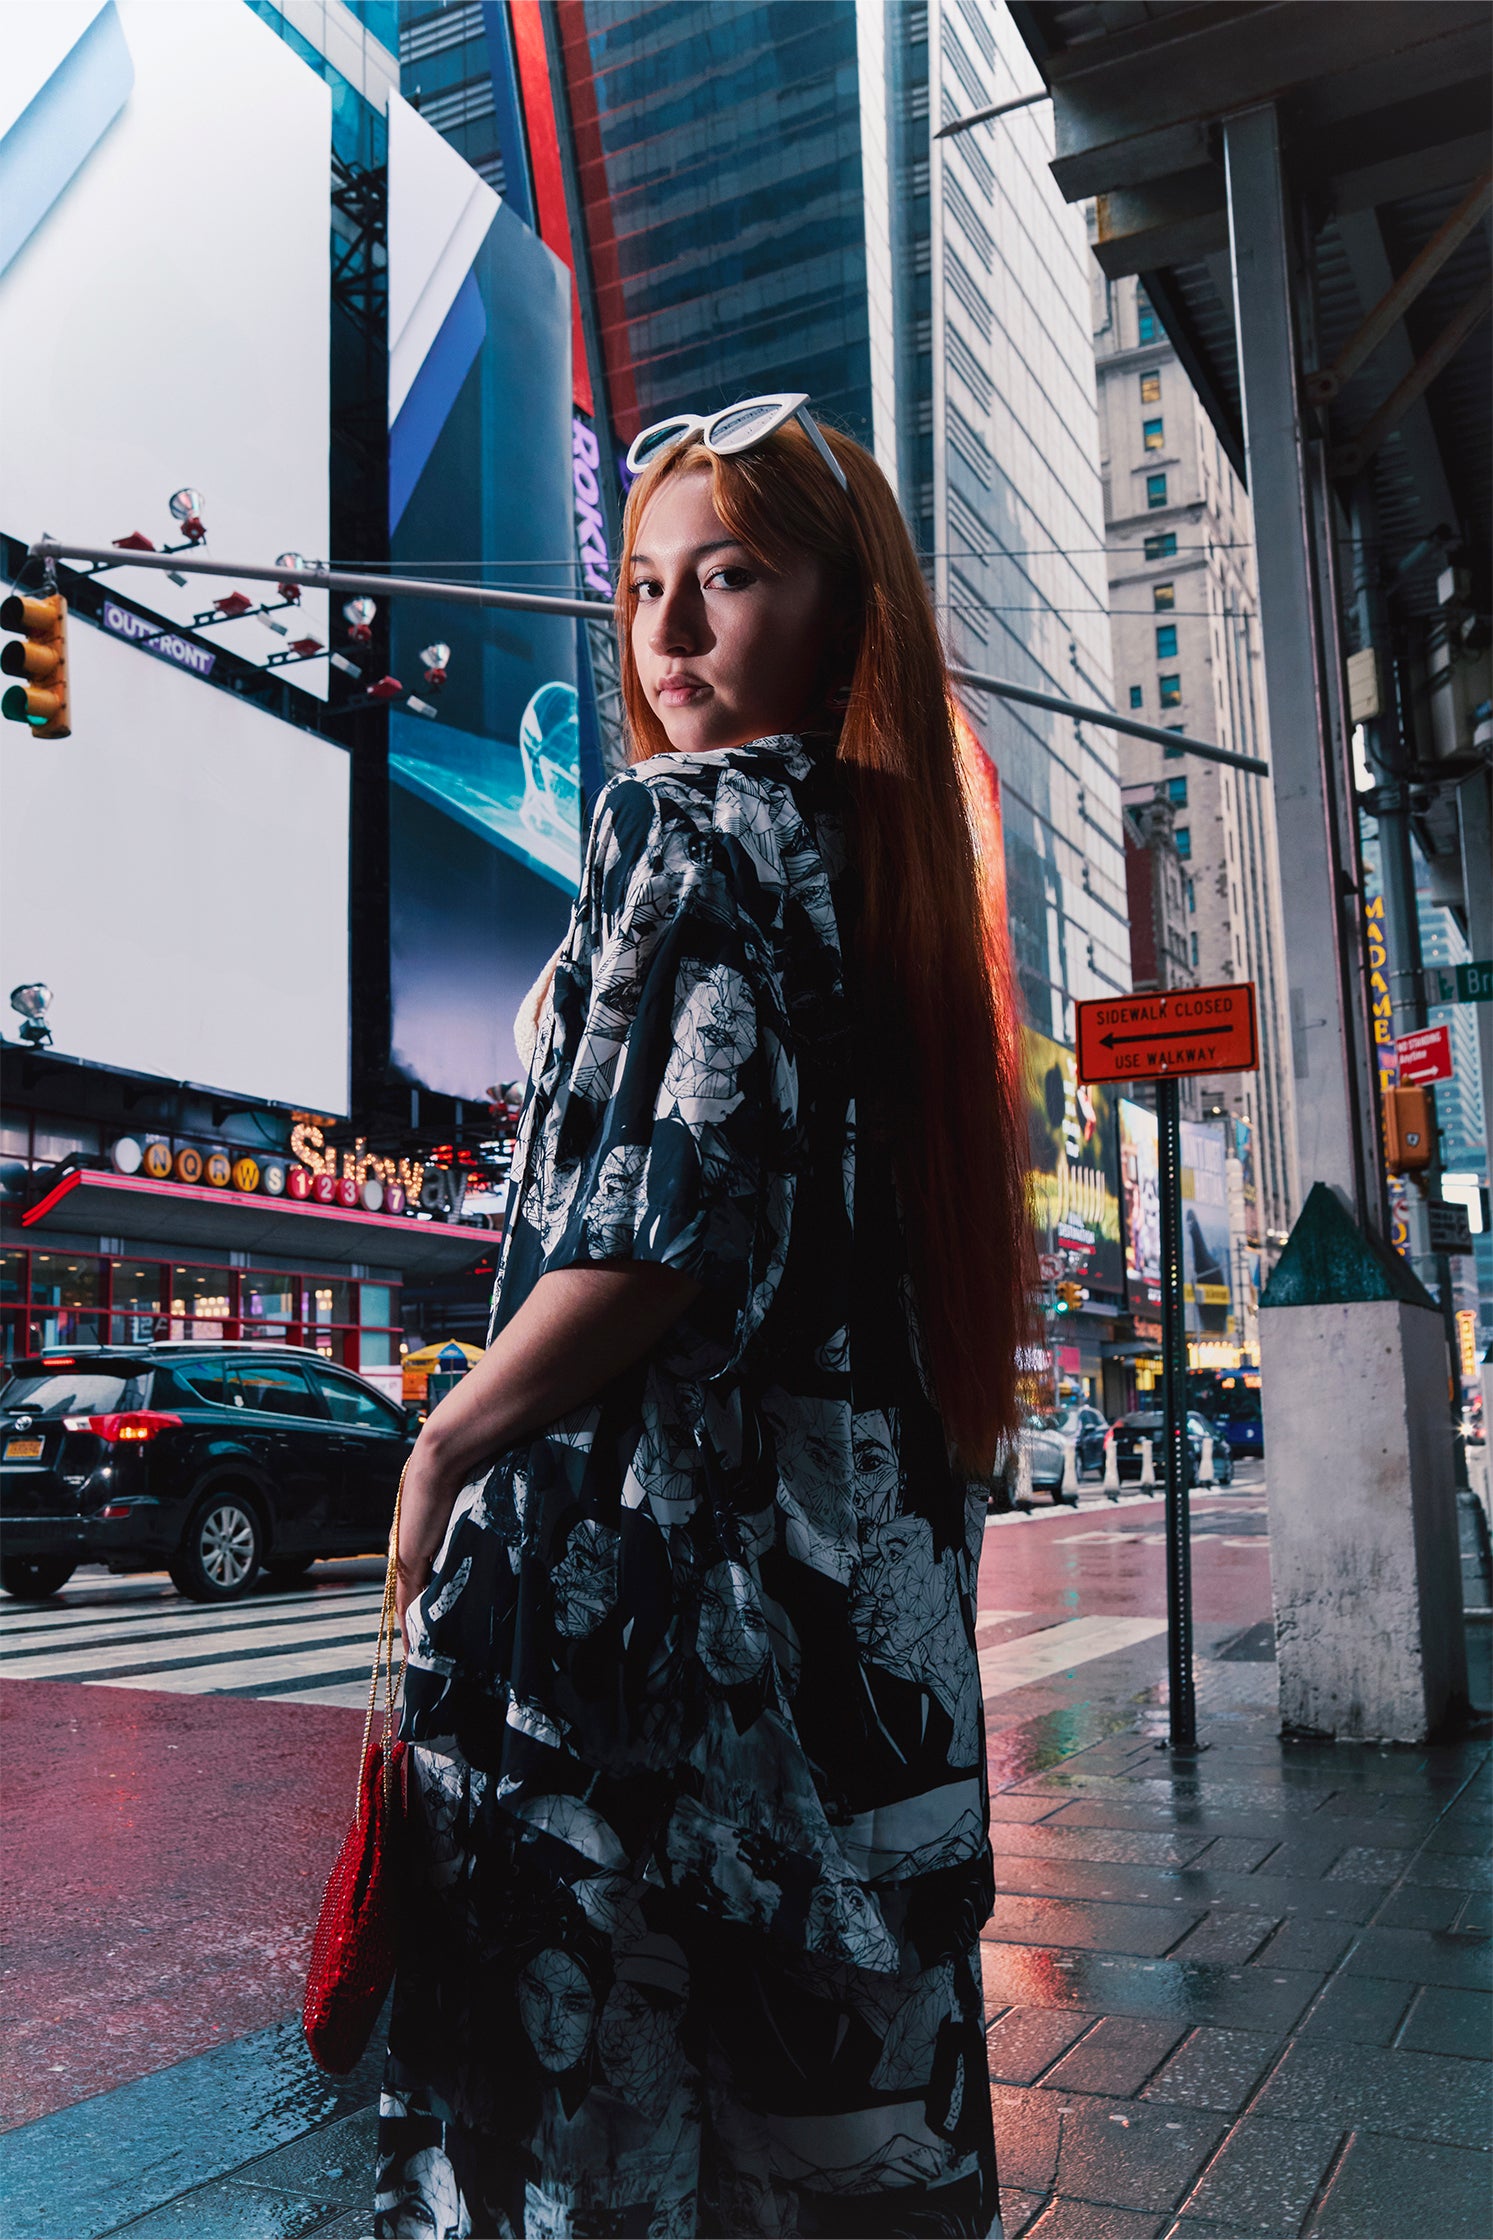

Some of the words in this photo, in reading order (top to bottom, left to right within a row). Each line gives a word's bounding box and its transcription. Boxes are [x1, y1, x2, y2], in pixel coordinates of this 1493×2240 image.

[573, 418, 613, 598] ROKU
[107, 606, 210, 672] OUTFRONT
[1365, 896, 1392, 1044] MADAME
[1467, 968, 1493, 993] Br
[1096, 1004, 1168, 1025] SIDEWALK
[1174, 998, 1233, 1018] CLOSED
[1115, 1053, 1140, 1070] USE
[1146, 1046, 1216, 1067] WALKWAY
[153, 1150, 167, 1172] N
[184, 1153, 198, 1177] Q
[212, 1158, 226, 1181] R
[240, 1165, 257, 1188] W
[268, 1167, 282, 1189] S
[296, 1172, 306, 1196] 1
[320, 1176, 333, 1199] 2
[344, 1180, 356, 1202] 3
[391, 1188, 402, 1210] 7
